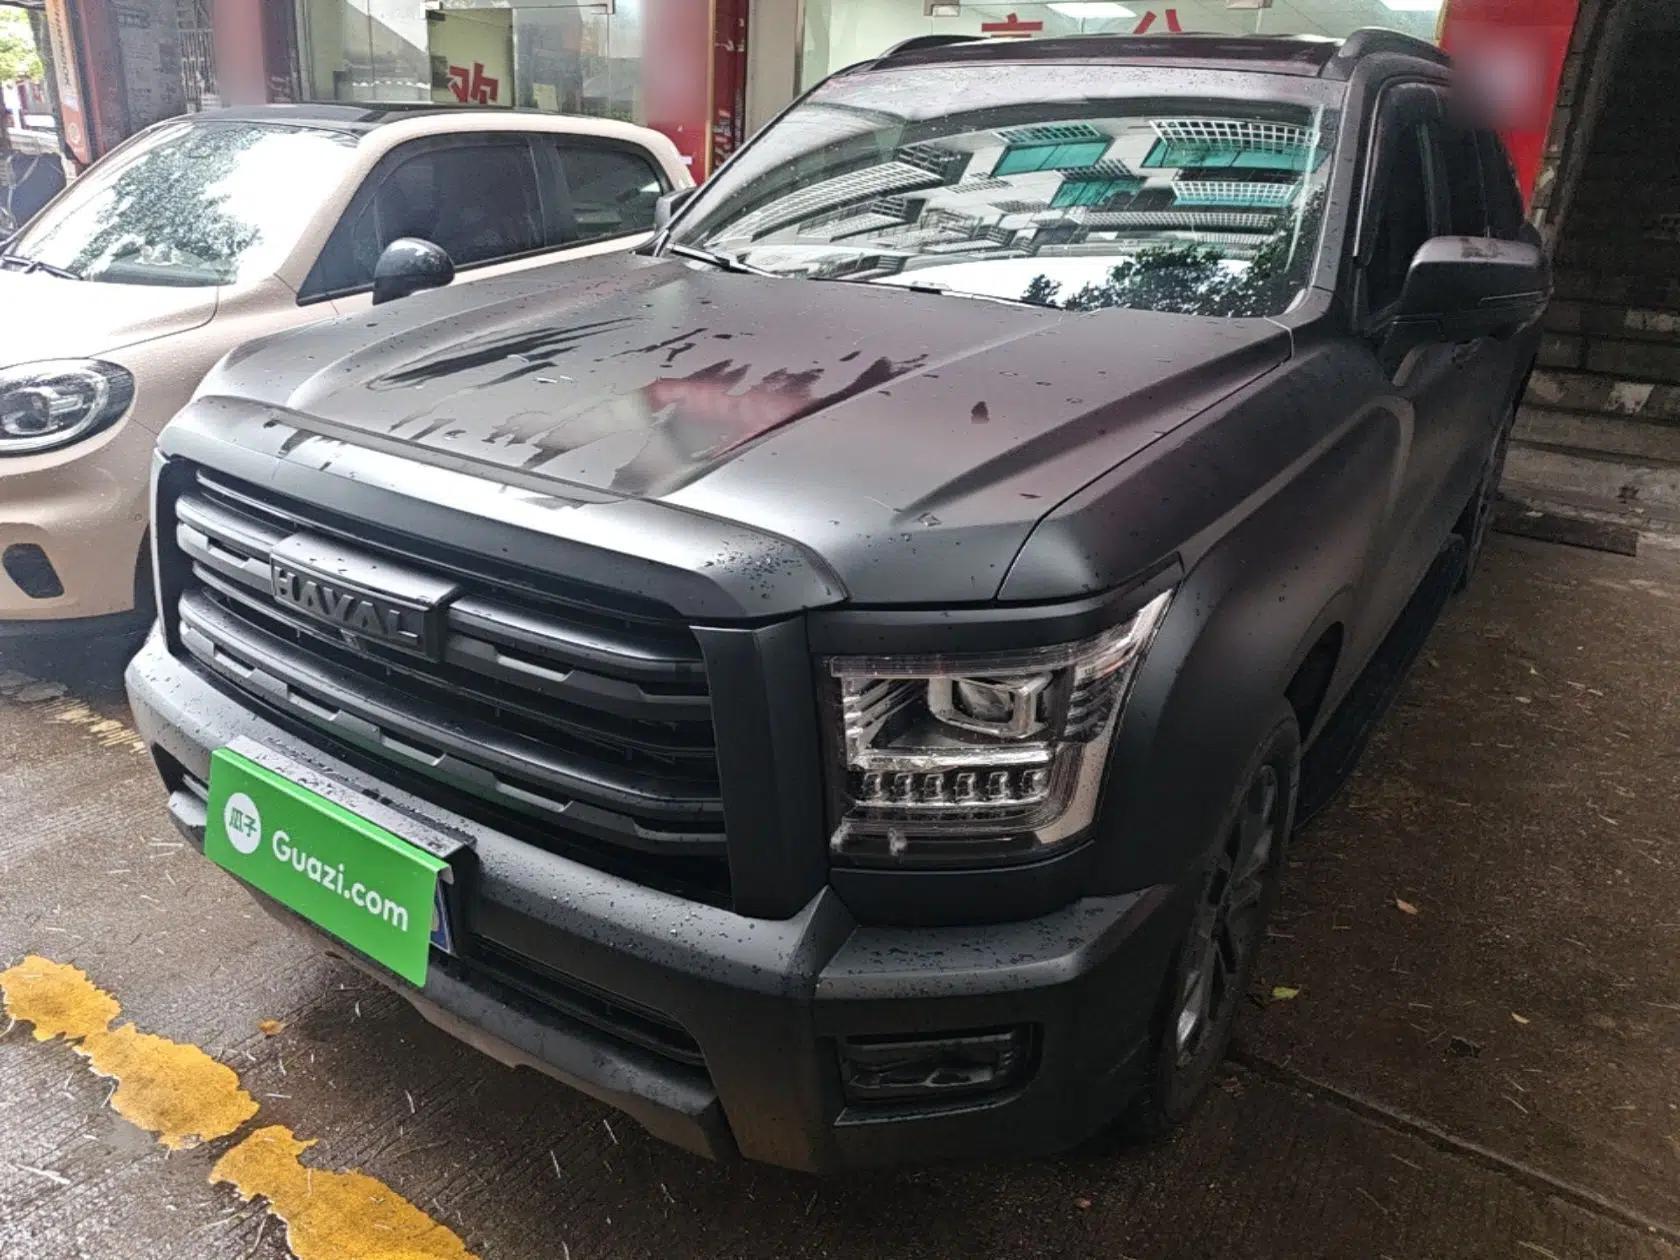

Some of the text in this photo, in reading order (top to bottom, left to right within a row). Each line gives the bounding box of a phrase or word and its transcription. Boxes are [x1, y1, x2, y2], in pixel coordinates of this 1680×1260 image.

[273, 565, 419, 646] HAVAL
[229, 807, 258, 838] 瓜子
[271, 830, 409, 932] Guazi.com
